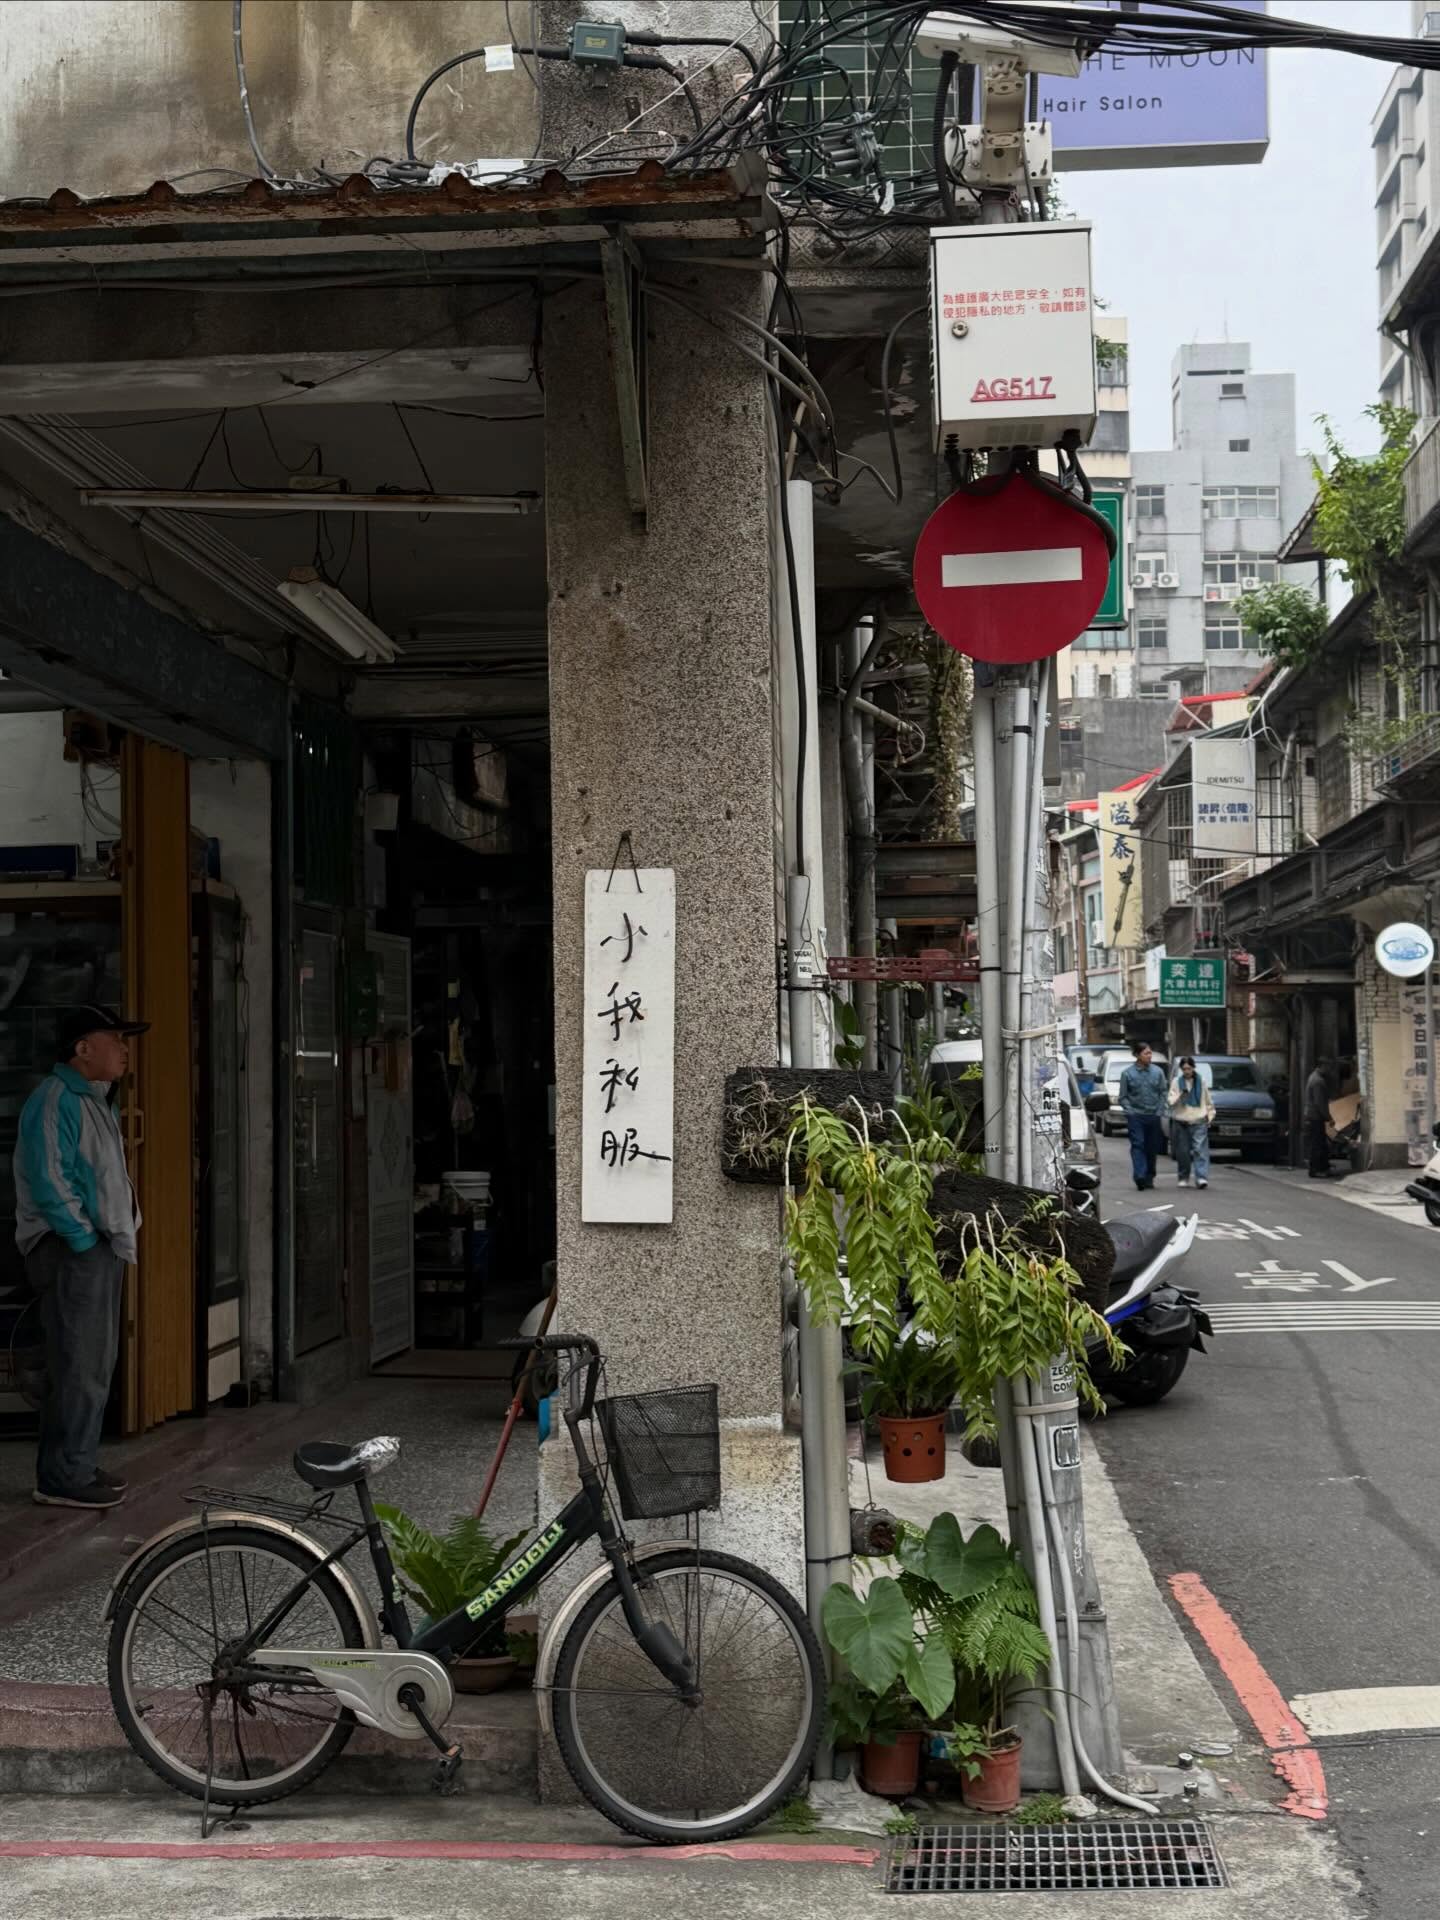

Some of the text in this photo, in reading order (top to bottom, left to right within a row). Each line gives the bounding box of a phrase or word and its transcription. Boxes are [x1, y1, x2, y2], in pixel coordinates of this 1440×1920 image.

[1086, 47, 1256, 71] HE MOON
[1043, 95, 1163, 113] Hair Salon
[974, 376, 1053, 400] AG517
[1109, 800, 1135, 860] 溢泰
